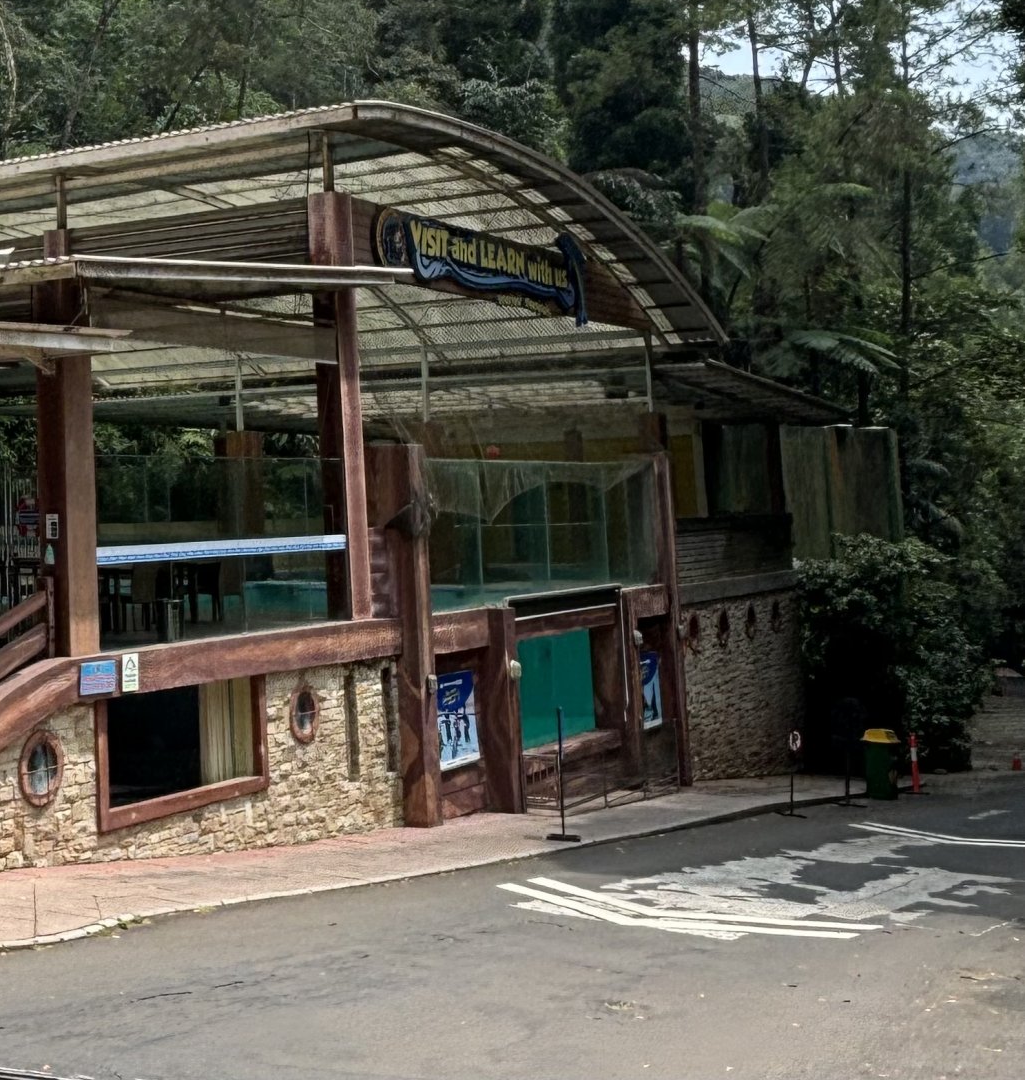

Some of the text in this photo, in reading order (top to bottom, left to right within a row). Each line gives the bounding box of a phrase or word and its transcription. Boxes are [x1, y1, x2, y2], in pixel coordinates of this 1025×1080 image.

[410, 221, 568, 289] VISIT and LEARN with us
